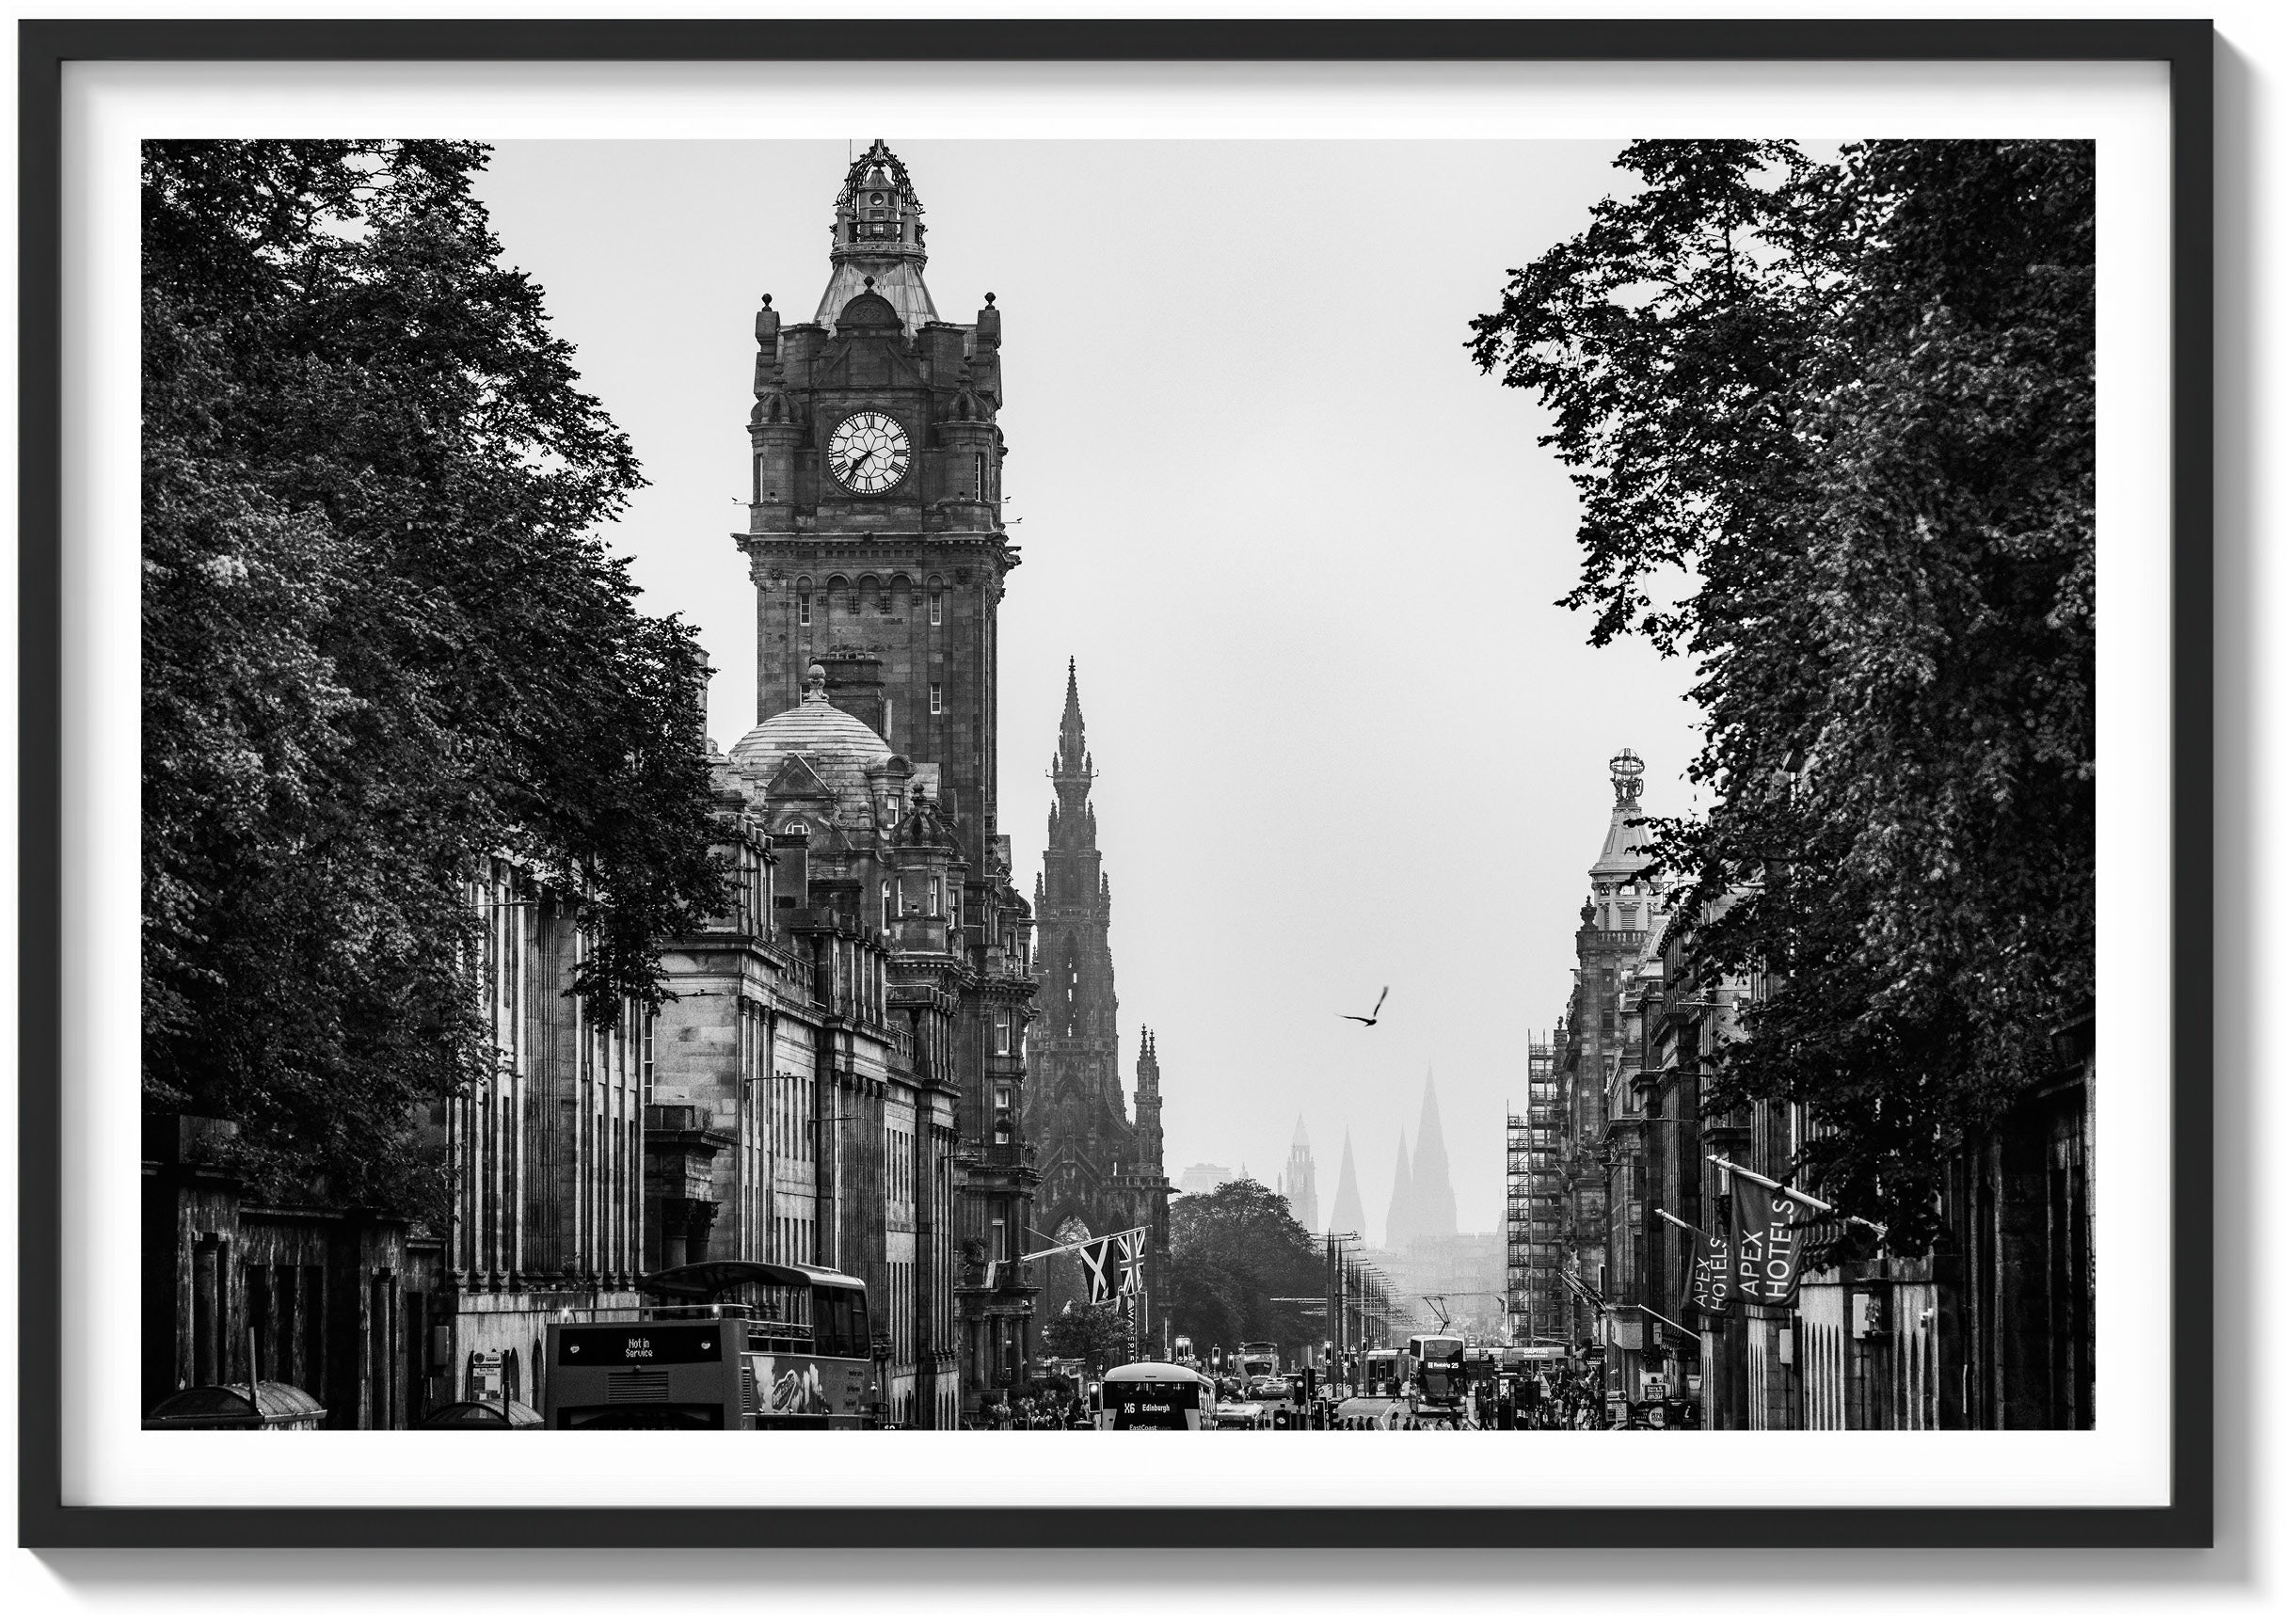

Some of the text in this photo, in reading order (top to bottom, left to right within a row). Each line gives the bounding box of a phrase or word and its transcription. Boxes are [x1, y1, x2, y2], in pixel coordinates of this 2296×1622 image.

[1739, 1230, 1763, 1296] APEX
[1765, 1200, 1794, 1297] HOTELS
[1692, 1256, 1711, 1309] APEX
[625, 1348, 653, 1358] Service
[629, 1338, 650, 1349] Not in
[1124, 1403, 1171, 1414] X6 Edinburgh
